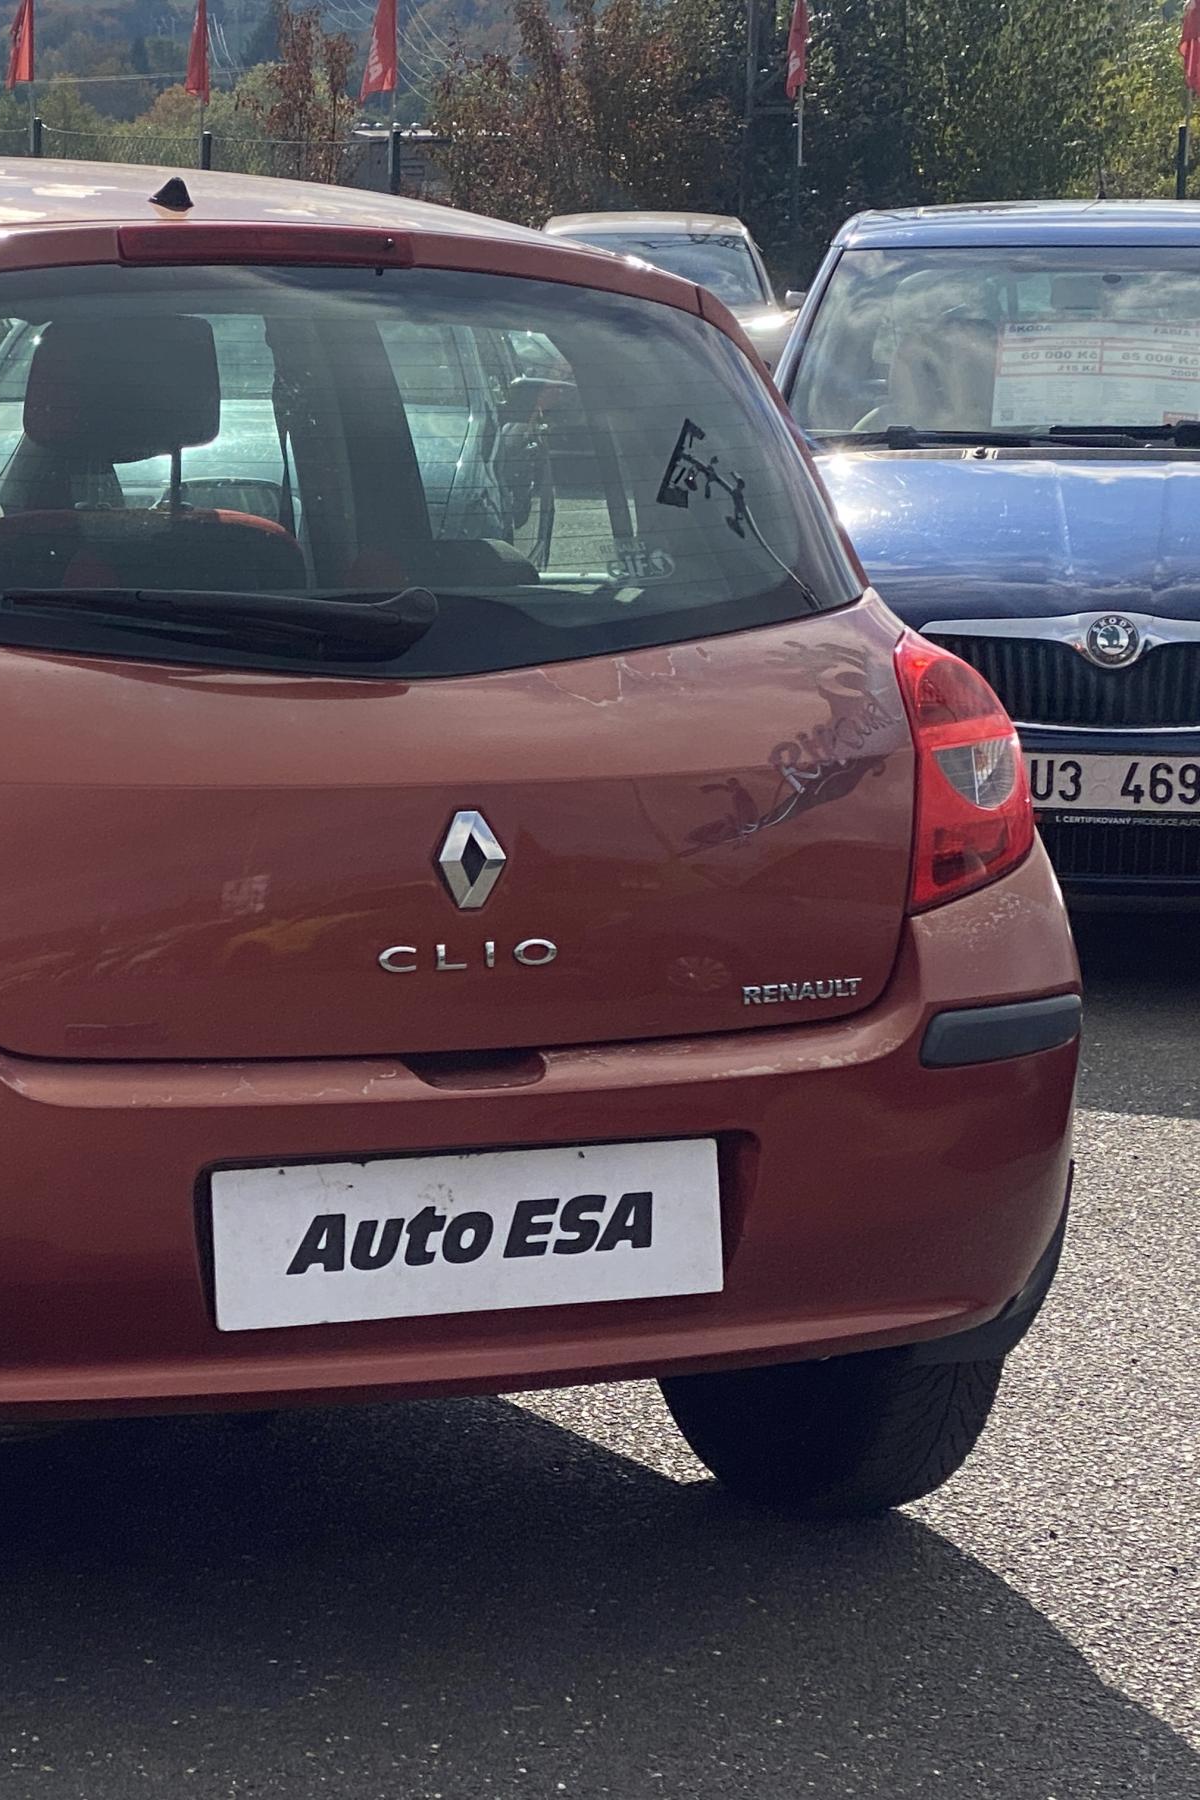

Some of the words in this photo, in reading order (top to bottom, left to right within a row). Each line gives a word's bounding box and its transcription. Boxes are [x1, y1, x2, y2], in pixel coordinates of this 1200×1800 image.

[1021, 352, 1039, 360] 60
[1044, 351, 1072, 360] 000
[1030, 759, 1082, 802] U3
[1120, 762, 1200, 805] 469
[378, 938, 558, 972] CLIO
[742, 977, 863, 1005] RENAULT
[285, 1205, 494, 1276] Auto
[503, 1191, 653, 1259] ESA
